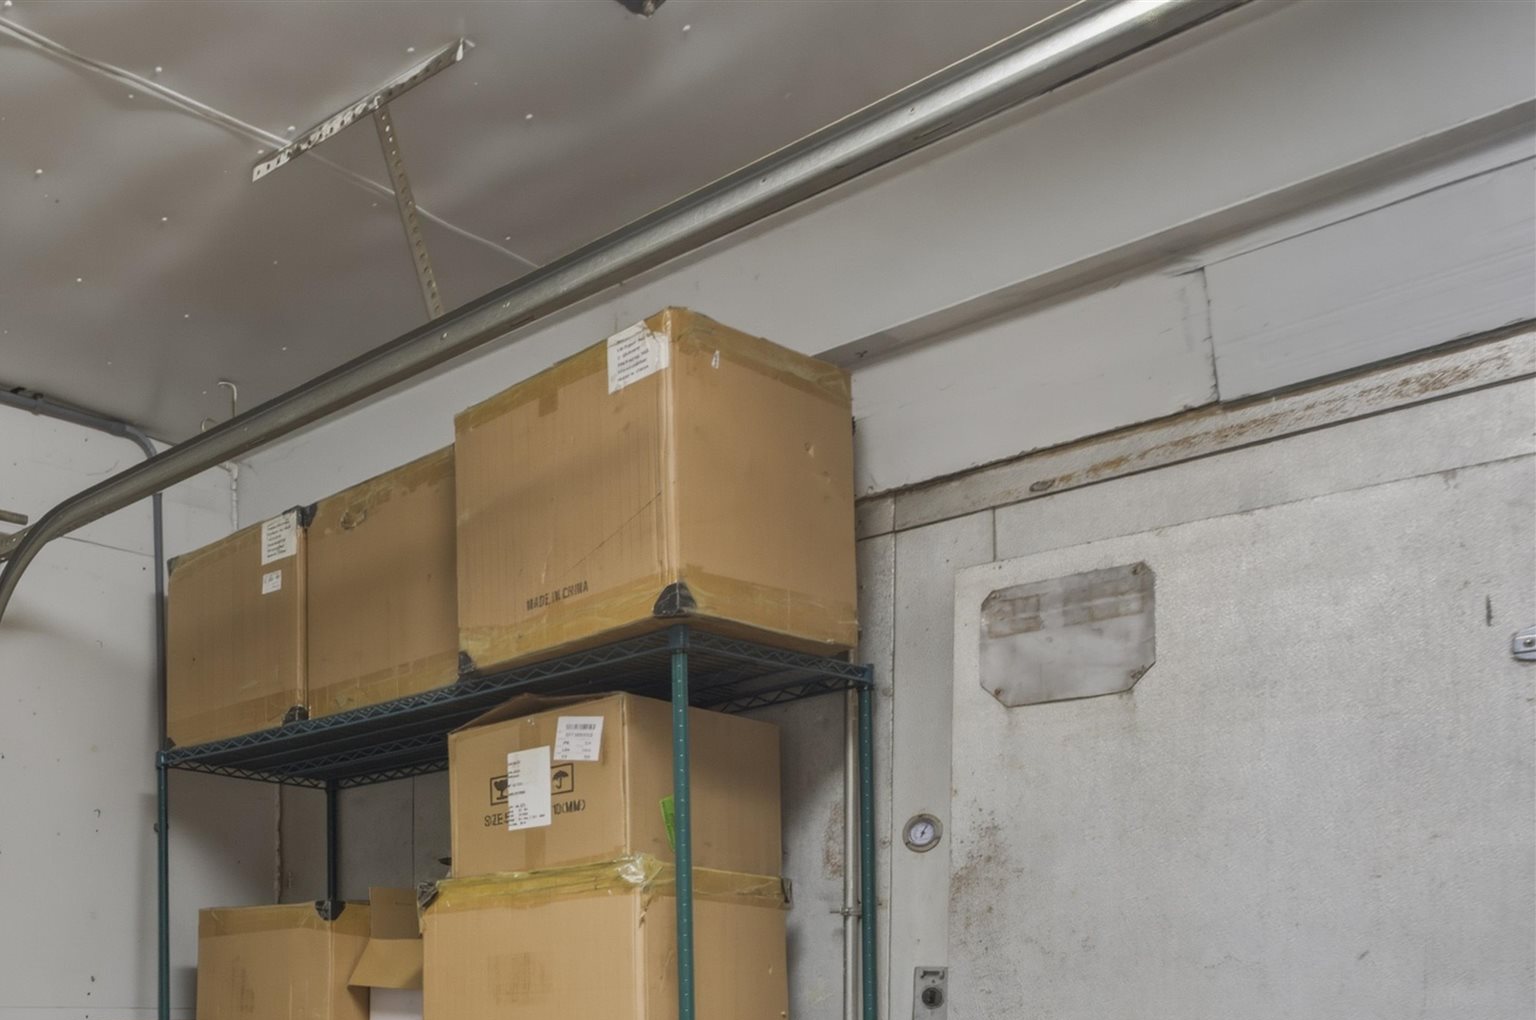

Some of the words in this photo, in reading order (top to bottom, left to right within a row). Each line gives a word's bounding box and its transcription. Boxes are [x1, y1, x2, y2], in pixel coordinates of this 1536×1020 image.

[526, 593, 549, 611] MADE
[550, 590, 561, 603] IN
[562, 581, 588, 600] CHINA
